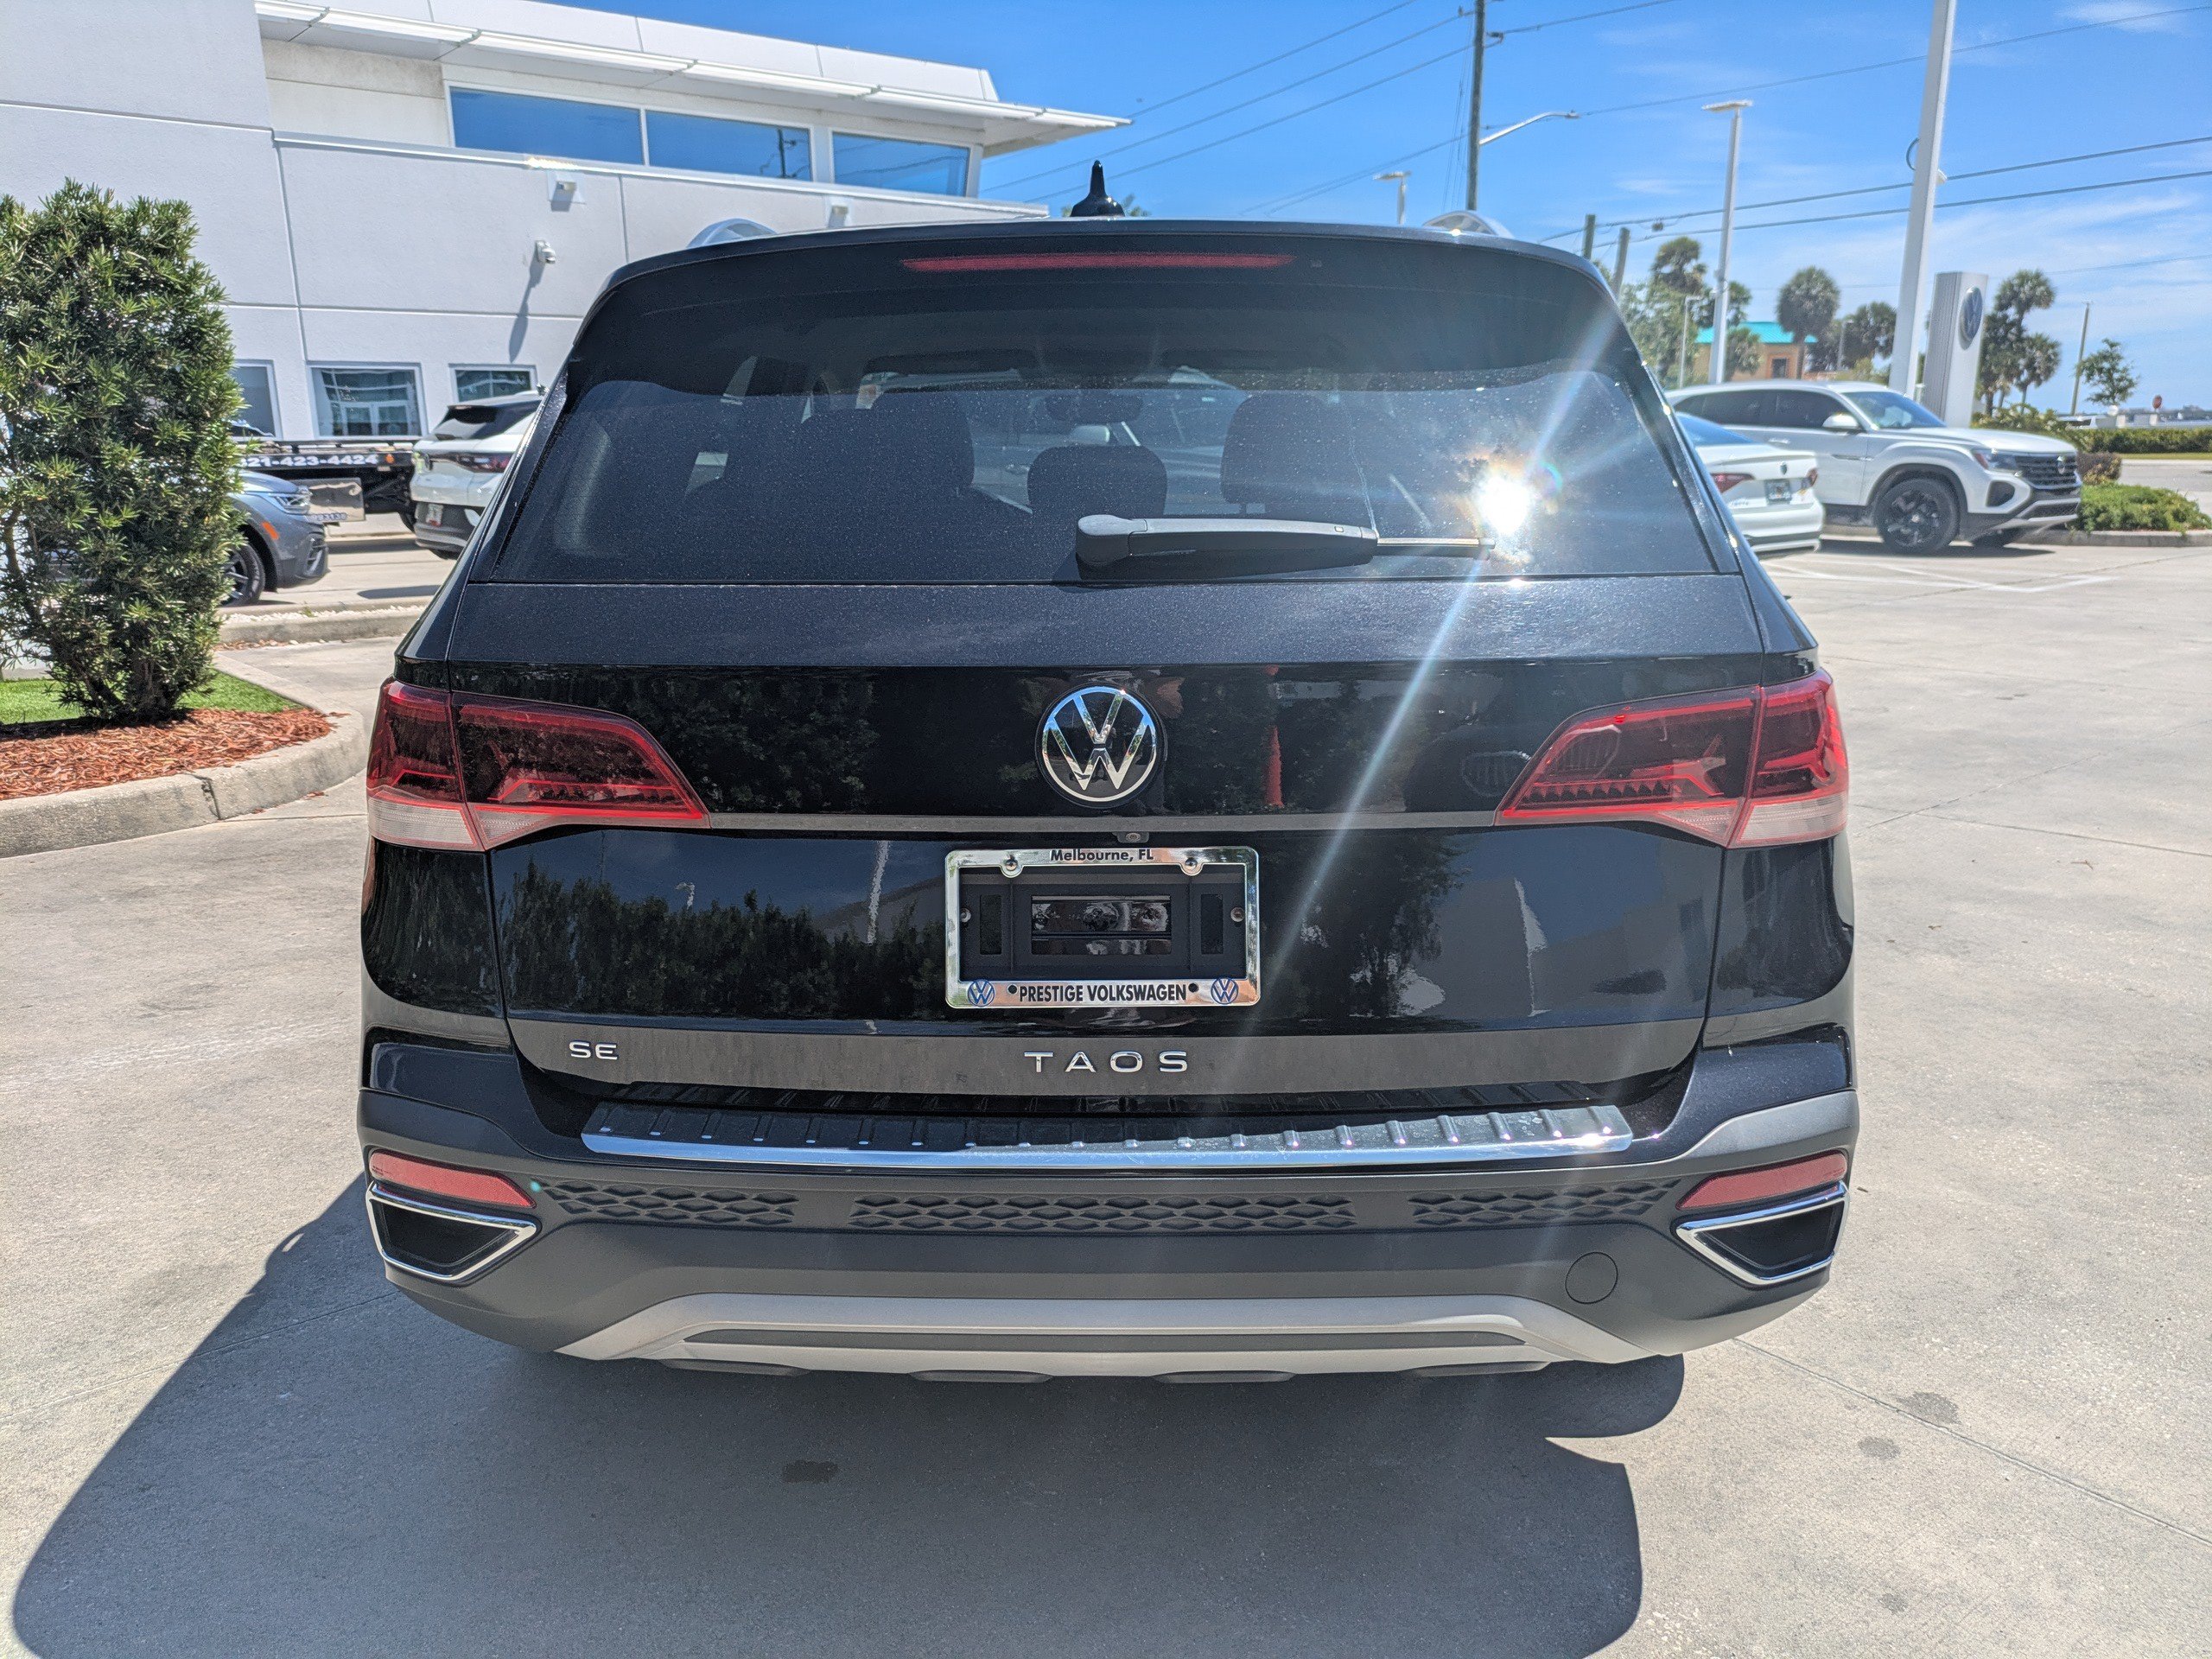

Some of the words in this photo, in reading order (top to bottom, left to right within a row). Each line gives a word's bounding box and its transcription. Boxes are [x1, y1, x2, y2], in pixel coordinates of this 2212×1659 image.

[1042, 686, 1156, 802] VW
[1050, 849, 1134, 861] Melbourne,
[1138, 849, 1154, 861] FL
[968, 979, 995, 1007] VW
[1019, 985, 1084, 1002] PRESTIGE
[1087, 983, 1187, 1001] VOLKSWAGEN
[1211, 977, 1239, 1004] VW
[569, 1040, 618, 1060] SE
[1024, 1050, 1188, 1073] TAOS
